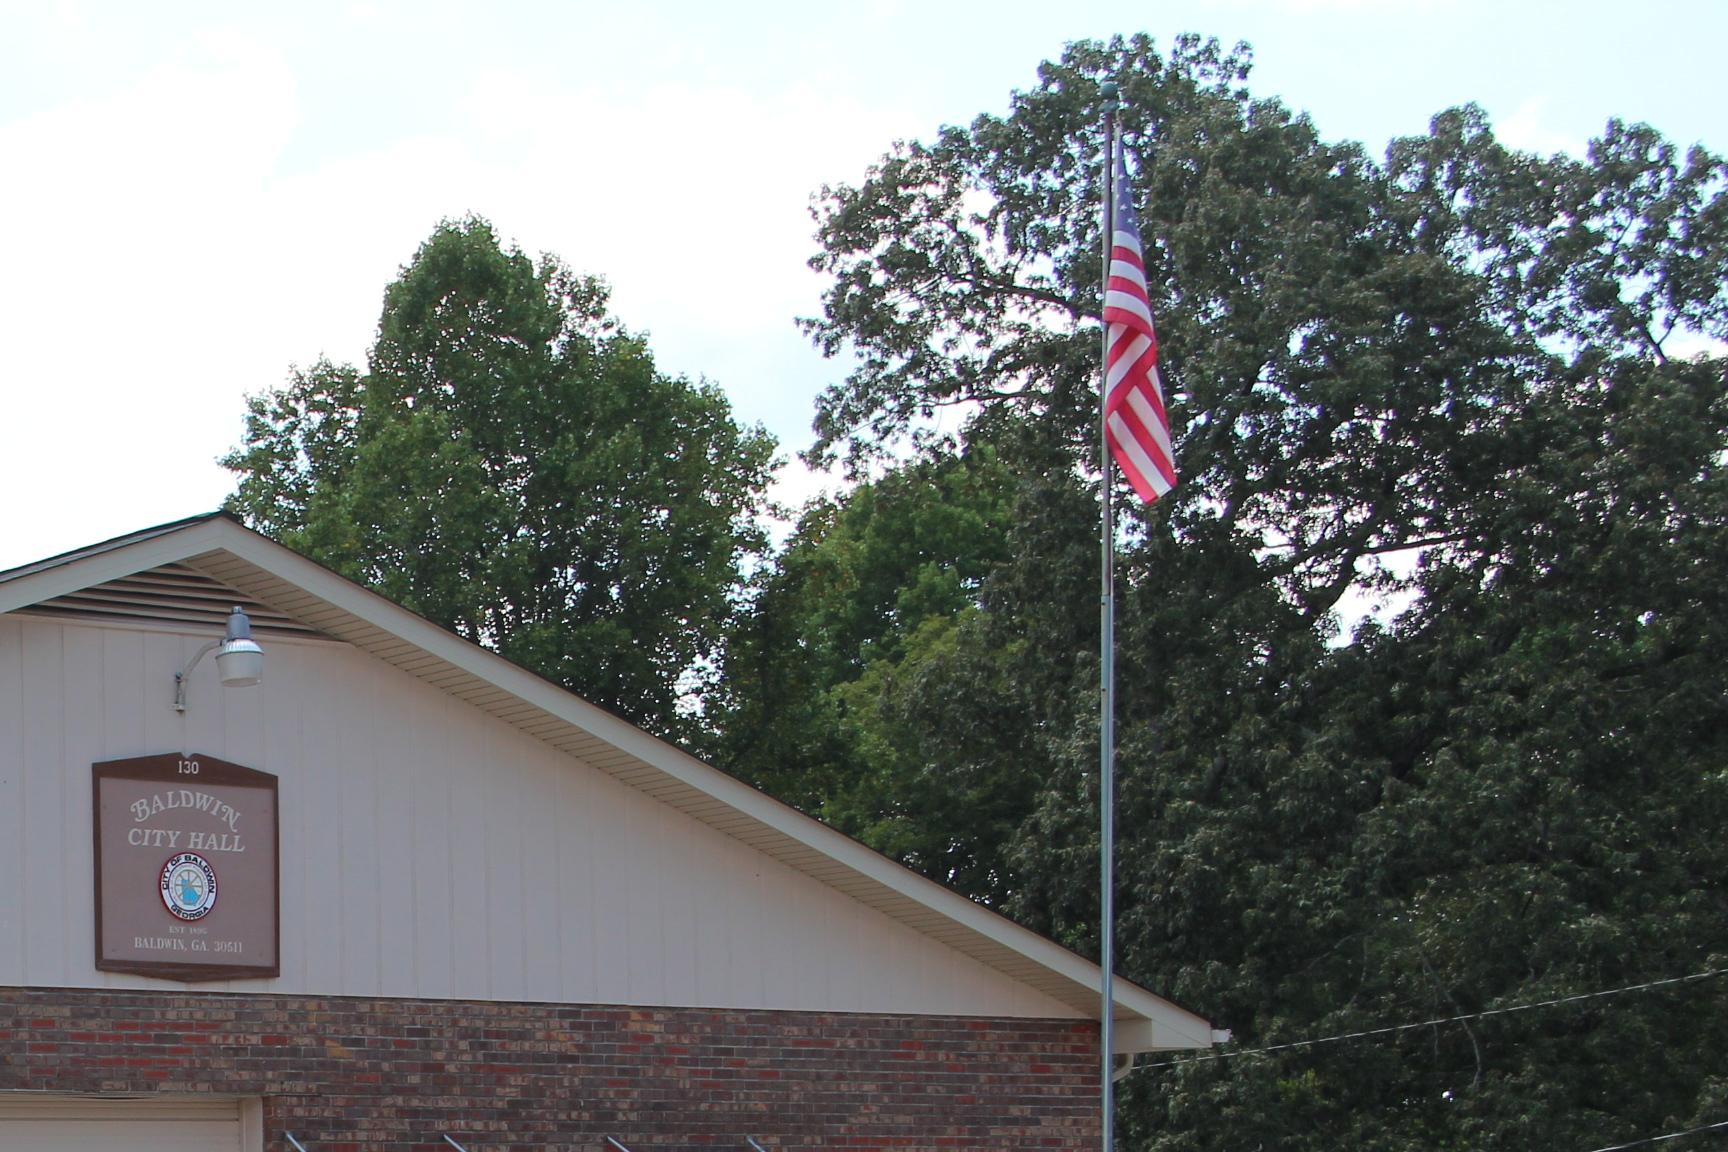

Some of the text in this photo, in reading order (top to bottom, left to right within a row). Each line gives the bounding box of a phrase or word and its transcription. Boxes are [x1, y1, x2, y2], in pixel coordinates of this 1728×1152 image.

[178, 761, 199, 774] 130
[130, 790, 241, 832] BALDWIN
[128, 828, 245, 852] CITY HALL
[162, 867, 170, 890] CITY
[170, 856, 182, 866] OF
[184, 855, 215, 893] BALDWIN
[171, 904, 209, 919] GEORGIA
[169, 926, 186, 934] EST
[134, 937, 243, 953] BALDWIN, GA. 30511
